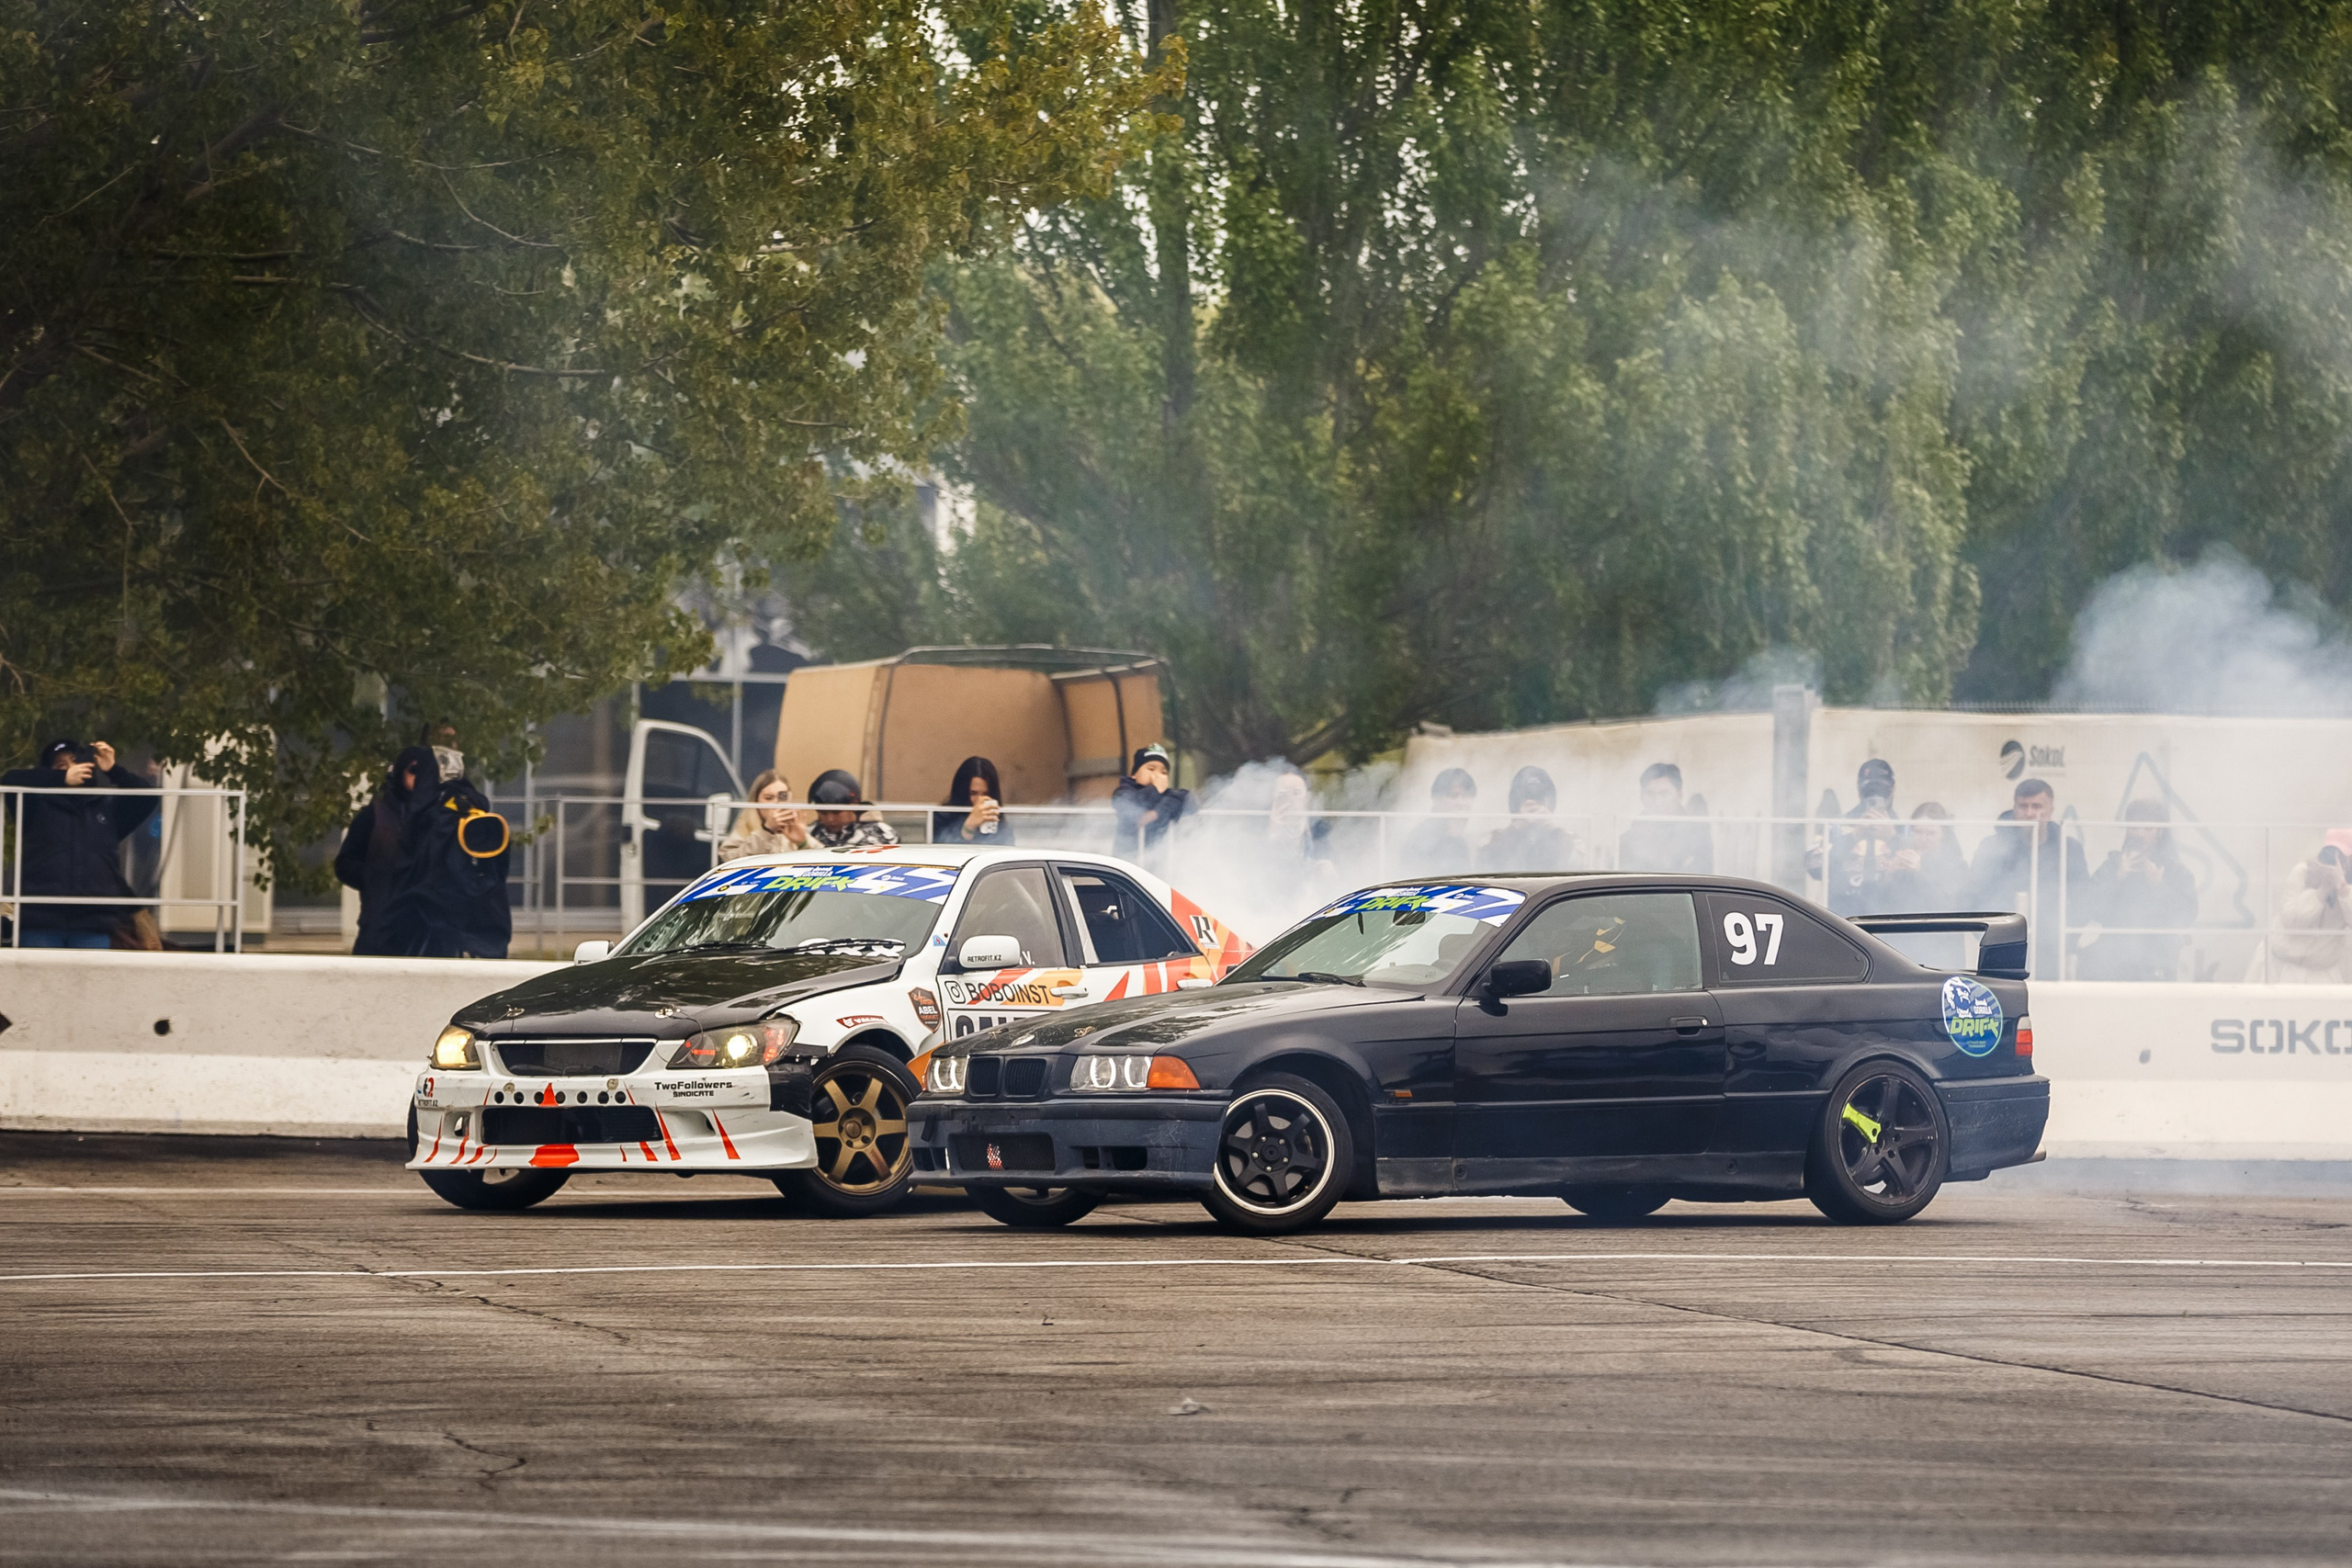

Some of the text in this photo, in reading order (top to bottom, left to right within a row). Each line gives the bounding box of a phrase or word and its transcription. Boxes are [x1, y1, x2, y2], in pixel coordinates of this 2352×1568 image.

[761, 876, 855, 892] DRIFT
[1353, 895, 1432, 911] DRIFT
[1723, 911, 1784, 965] 97
[967, 954, 1002, 963] RETROFIT.KZ
[964, 982, 1050, 1005] BOBOINST
[919, 1005, 938, 1015] ABEL
[1950, 1016, 1999, 1039] DRIFT
[654, 1081, 734, 1090] TwoFollowers
